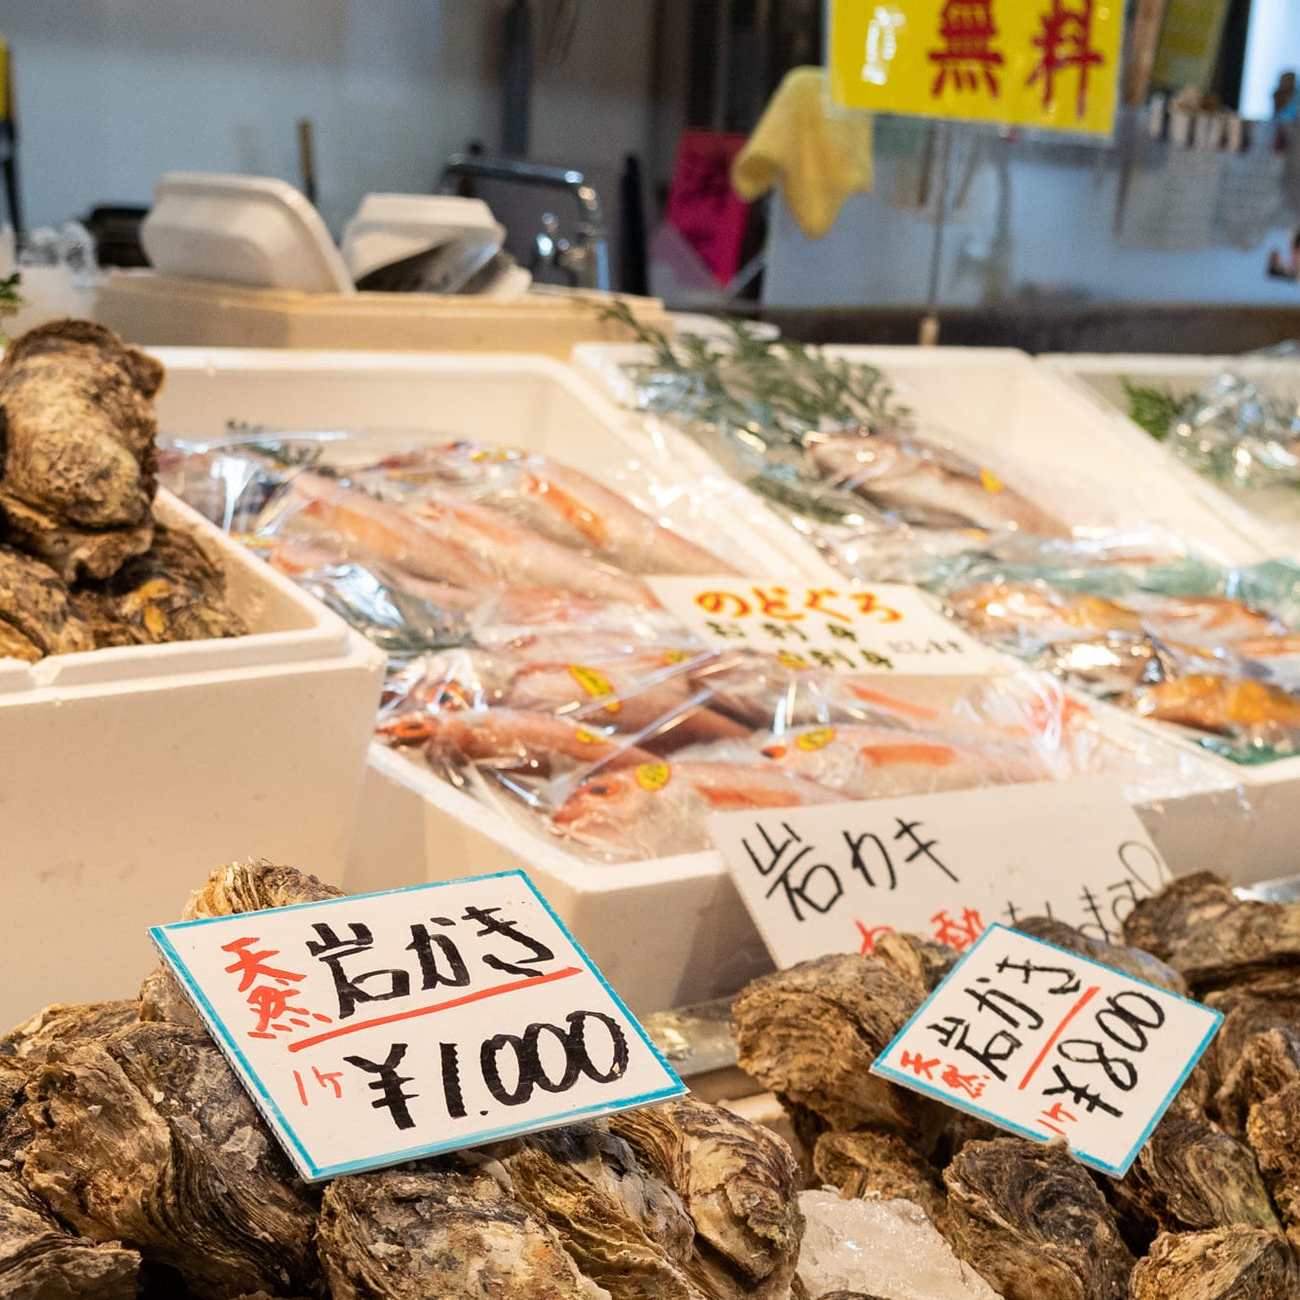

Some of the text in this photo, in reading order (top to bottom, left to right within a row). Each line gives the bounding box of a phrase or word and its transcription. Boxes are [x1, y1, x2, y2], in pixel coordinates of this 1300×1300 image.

[927, 0, 1104, 118] 無料
[694, 586, 903, 623] のどぐろ
[221, 936, 332, 1039] 天然
[306, 905, 555, 1019] 岩かき
[927, 955, 1082, 1082] 岩かき
[900, 1050, 991, 1100] 天然
[1042, 991, 1166, 1119] ¥800
